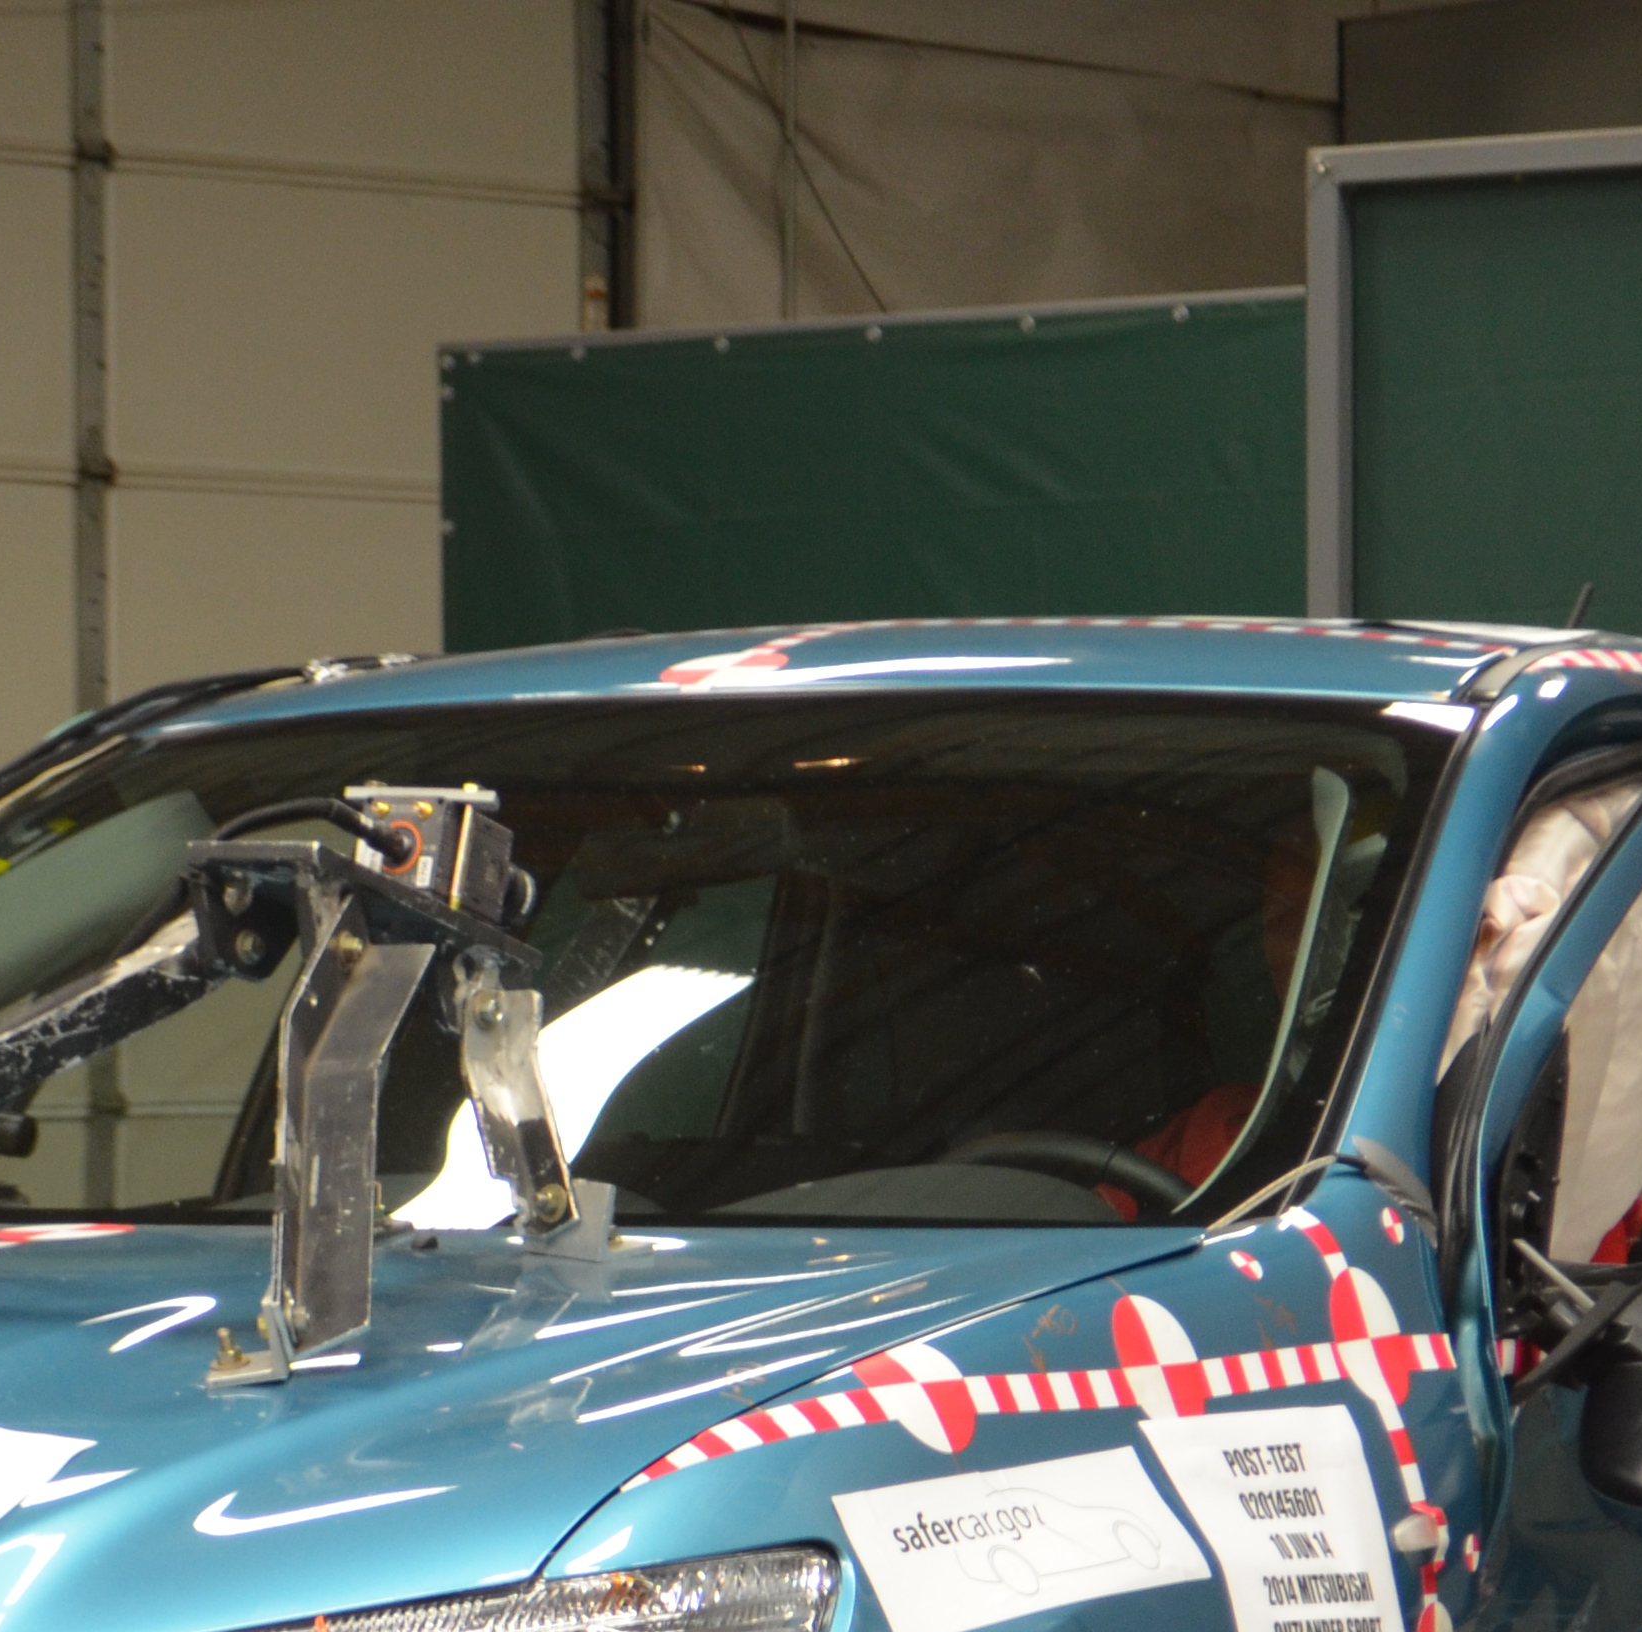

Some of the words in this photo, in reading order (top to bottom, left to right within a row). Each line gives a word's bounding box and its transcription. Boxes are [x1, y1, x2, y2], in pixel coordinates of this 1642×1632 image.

[1223, 1443, 1306, 1477] POST-TEST
[1239, 1488, 1325, 1520] 020145601
[893, 1503, 1045, 1553] safercar.gov
[1269, 1532, 1294, 1560] 10
[1285, 1531, 1320, 1559] JUN
[1312, 1530, 1334, 1558] 14
[1261, 1574, 1299, 1606] 2014
[1295, 1571, 1375, 1605] MITSUBISHI
